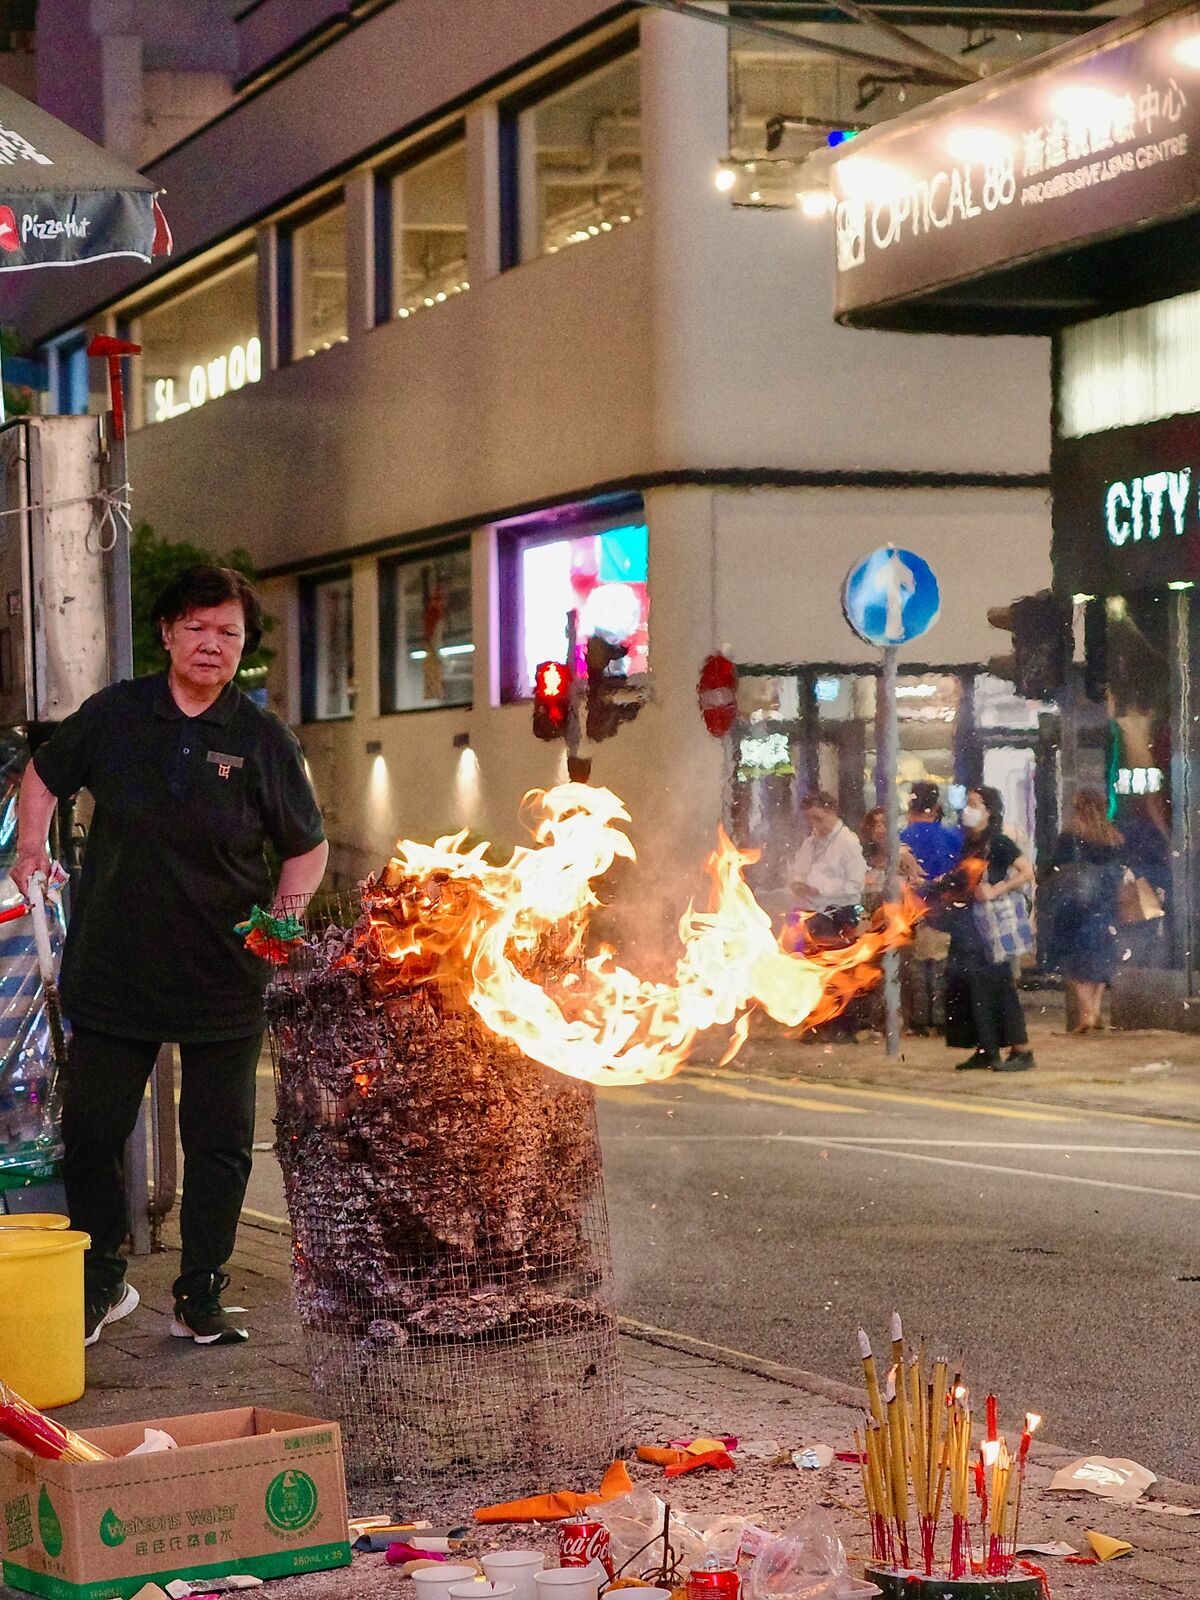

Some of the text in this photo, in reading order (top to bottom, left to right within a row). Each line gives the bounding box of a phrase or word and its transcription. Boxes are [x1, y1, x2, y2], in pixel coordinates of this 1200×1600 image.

[21, 213, 91, 243] Pizza Hut
[871, 163, 982, 249] OPTICAL
[983, 153, 1016, 212] 88
[1105, 467, 1192, 546] CITY
